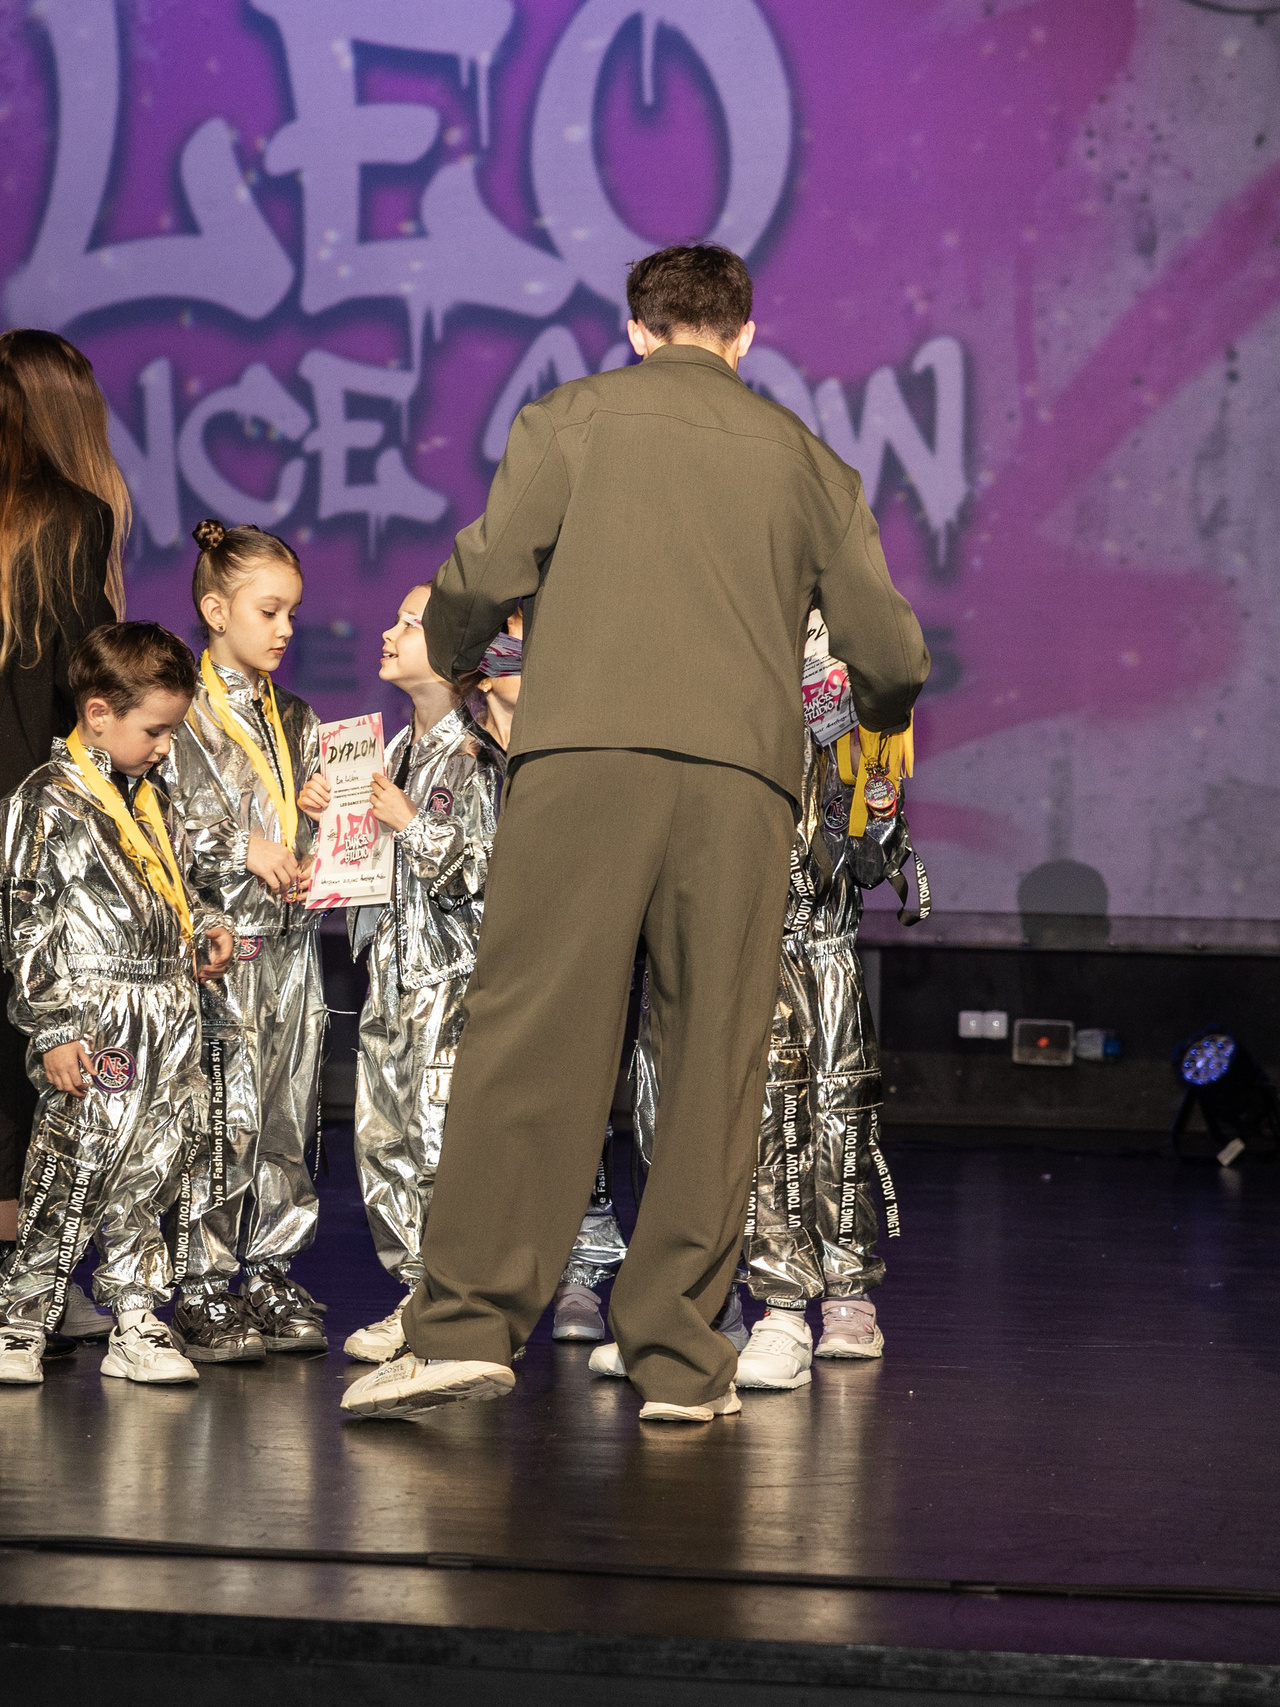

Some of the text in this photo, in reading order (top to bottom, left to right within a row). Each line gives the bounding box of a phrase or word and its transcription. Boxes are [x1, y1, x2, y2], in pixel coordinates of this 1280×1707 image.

[2, 0, 793, 328] LEO
[802, 669, 847, 703] EO
[327, 737, 377, 765] DYPLOM
[332, 808, 379, 857] LEO
[345, 833, 369, 850] DANCE
[429, 874, 447, 897] style
[917, 875, 930, 904] TONG
[212, 1064, 224, 1104] Fashion
[213, 1108, 226, 1137] style
[184, 1143, 200, 1170] TOUY
[212, 1138, 224, 1181] Fashion
[782, 1093, 802, 1228] UY TONG TOUY TONG TOUY
[871, 1149, 888, 1175] TONG
[39, 1163, 57, 1192] TOUY
[180, 1172, 191, 1199] TONG
[840, 1124, 858, 1234] TONG TOUY TONG TOUY
[880, 1174, 896, 1200] TOUY
[29, 1191, 47, 1220] TONG
[69, 1186, 88, 1214] TOUY
[213, 1184, 226, 1207] tyle
[178, 1200, 190, 1228] TOUY
[886, 1203, 900, 1228] TONG
[21, 1219, 35, 1246] TOUY
[61, 1216, 80, 1245] TONG
[58, 1244, 74, 1273] TOUY
[176, 1231, 189, 1260] TONG
[52, 1276, 68, 1304] TONG
[44, 1303, 63, 1331] TOUY
